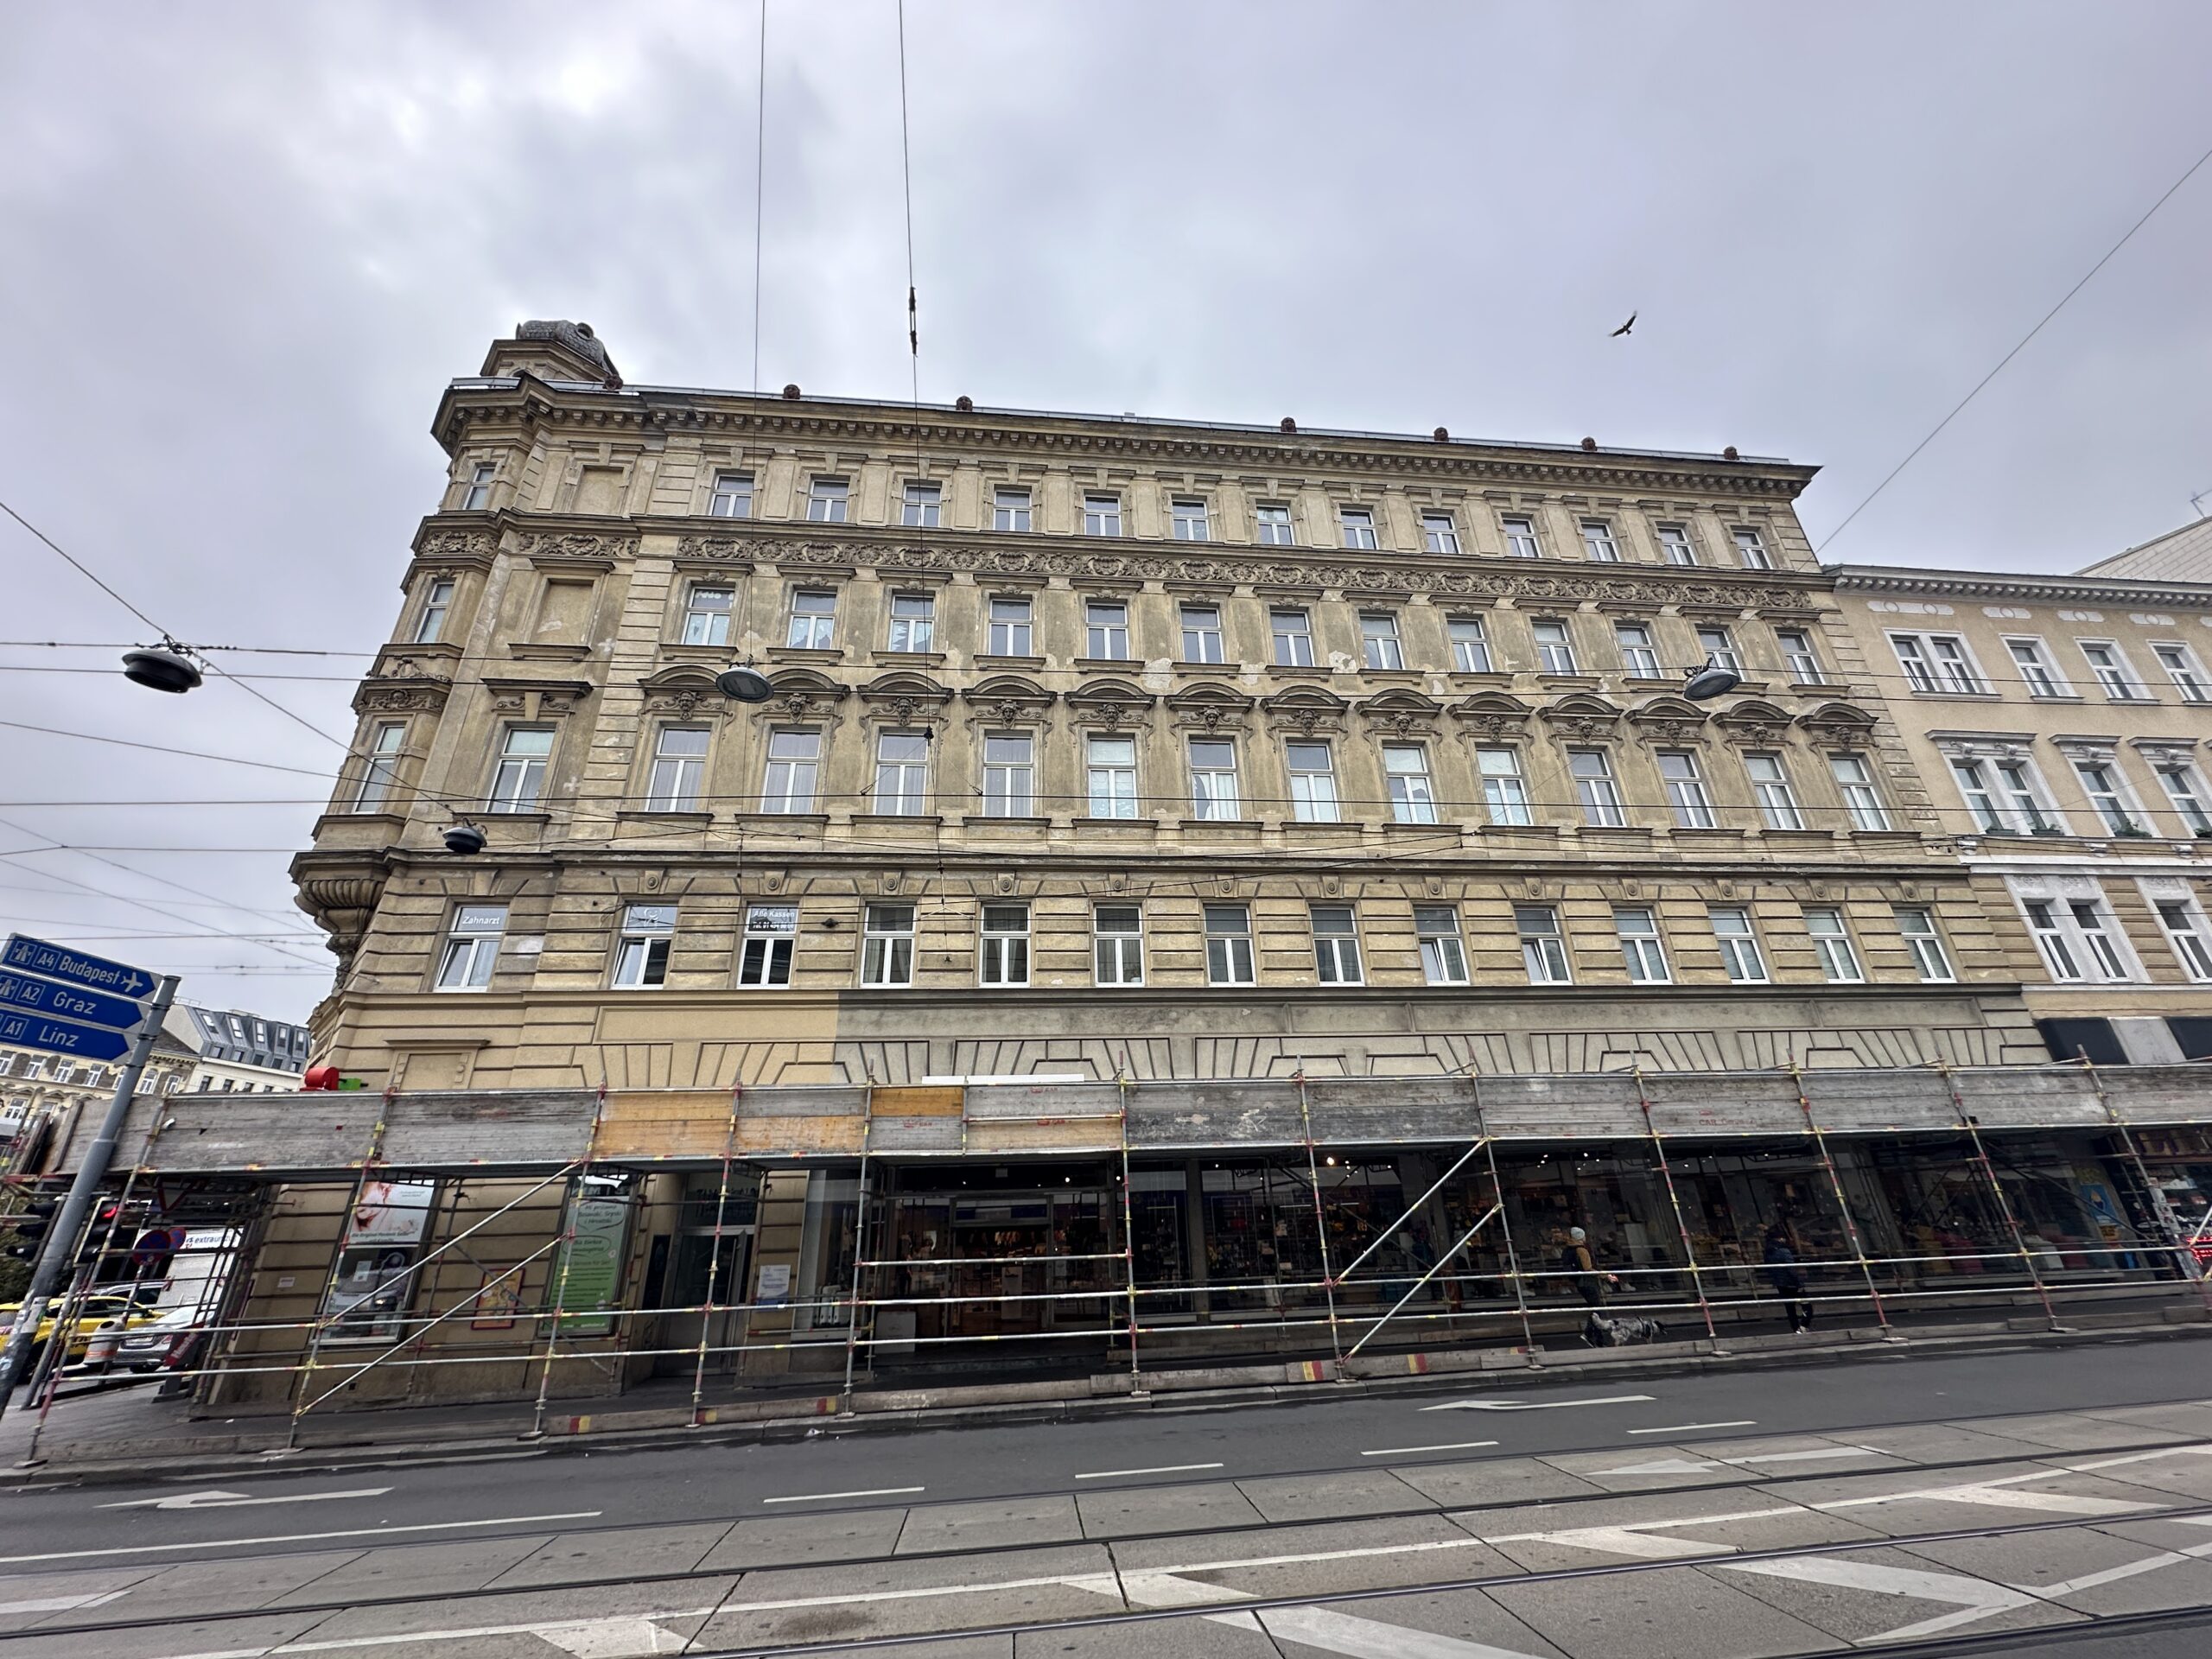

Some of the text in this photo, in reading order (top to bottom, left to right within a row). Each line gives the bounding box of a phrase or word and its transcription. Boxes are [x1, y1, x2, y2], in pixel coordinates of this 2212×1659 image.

[462, 916, 500, 925] Zahnarzt
[37, 952, 121, 984] A4 Budapest
[21, 986, 97, 1014] A2 Graz
[4, 1020, 79, 1047] A1 Linz
